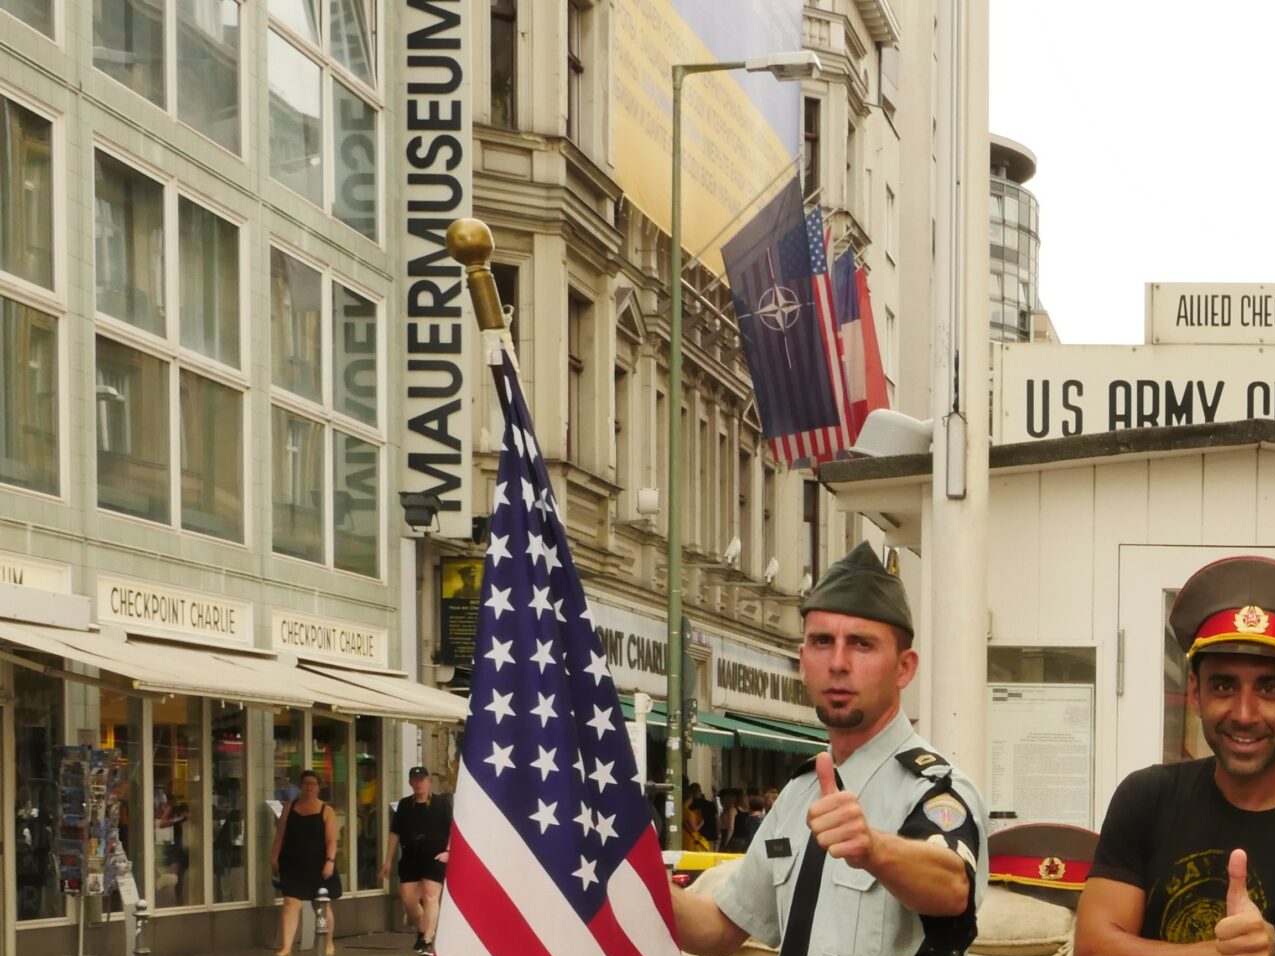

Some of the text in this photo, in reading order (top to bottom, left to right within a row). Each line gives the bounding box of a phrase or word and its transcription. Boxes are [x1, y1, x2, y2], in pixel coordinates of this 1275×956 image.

[406, 0, 464, 512] MAUERMUSEUM
[1175, 294, 1232, 328] ALLIED
[1108, 380, 1226, 432] ARMY
[110, 586, 236, 635] CHECKPOINT CHARLIE
[280, 619, 374, 658] CHECKPOINT CHARLIE
[627, 634, 669, 677] CHARLI
[717, 657, 769, 700] MAUERSHOP
